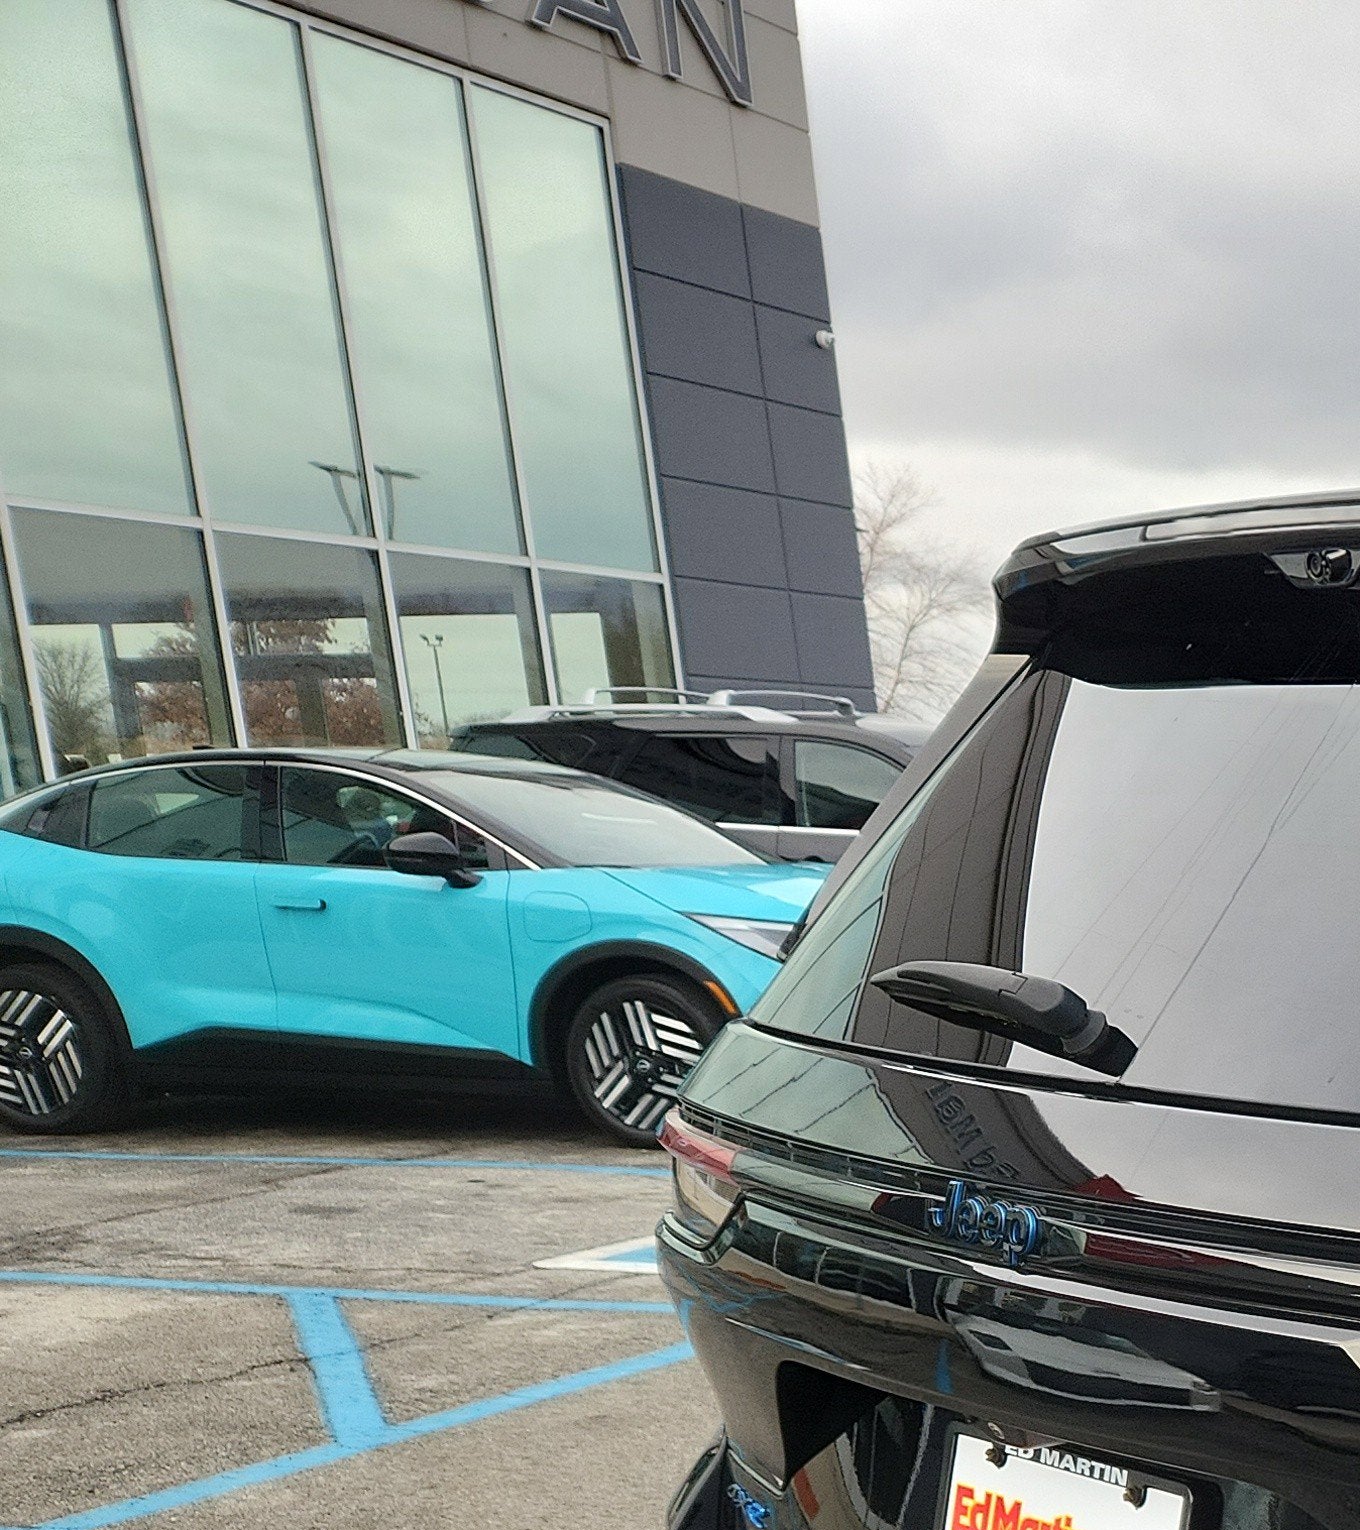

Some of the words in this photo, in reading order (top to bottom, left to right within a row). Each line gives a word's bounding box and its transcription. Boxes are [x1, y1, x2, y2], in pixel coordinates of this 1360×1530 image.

[927, 1179, 1039, 1266] Jeep
[1005, 1444, 1034, 1460] ED
[1040, 1447, 1129, 1488] MARTIN
